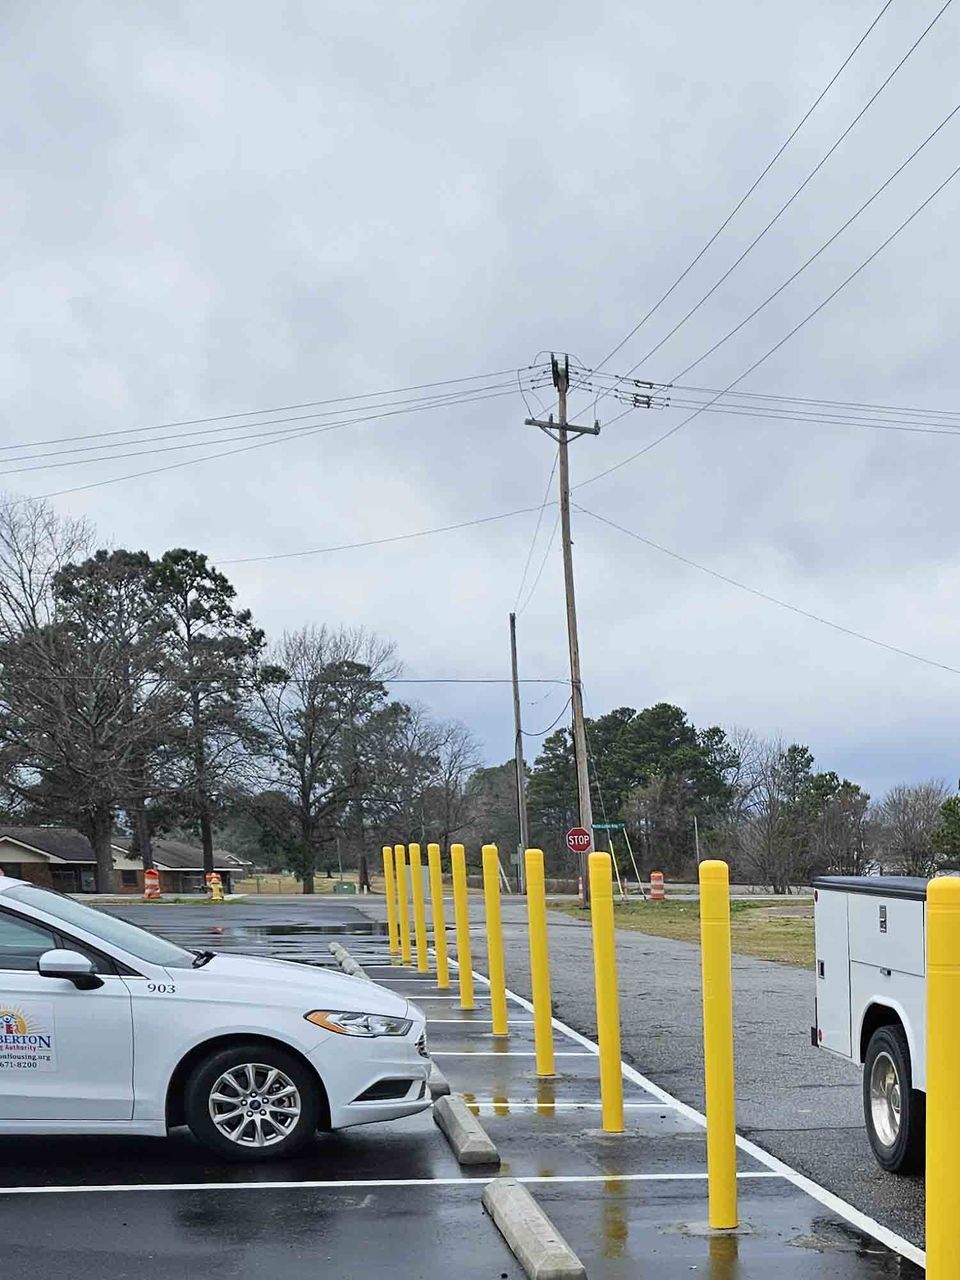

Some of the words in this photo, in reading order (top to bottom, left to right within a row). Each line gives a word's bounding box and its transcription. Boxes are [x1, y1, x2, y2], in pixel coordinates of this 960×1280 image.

[568, 835, 590, 845] STOP
[147, 983, 176, 994] 903
[5, 1044, 37, 1052] Authority
